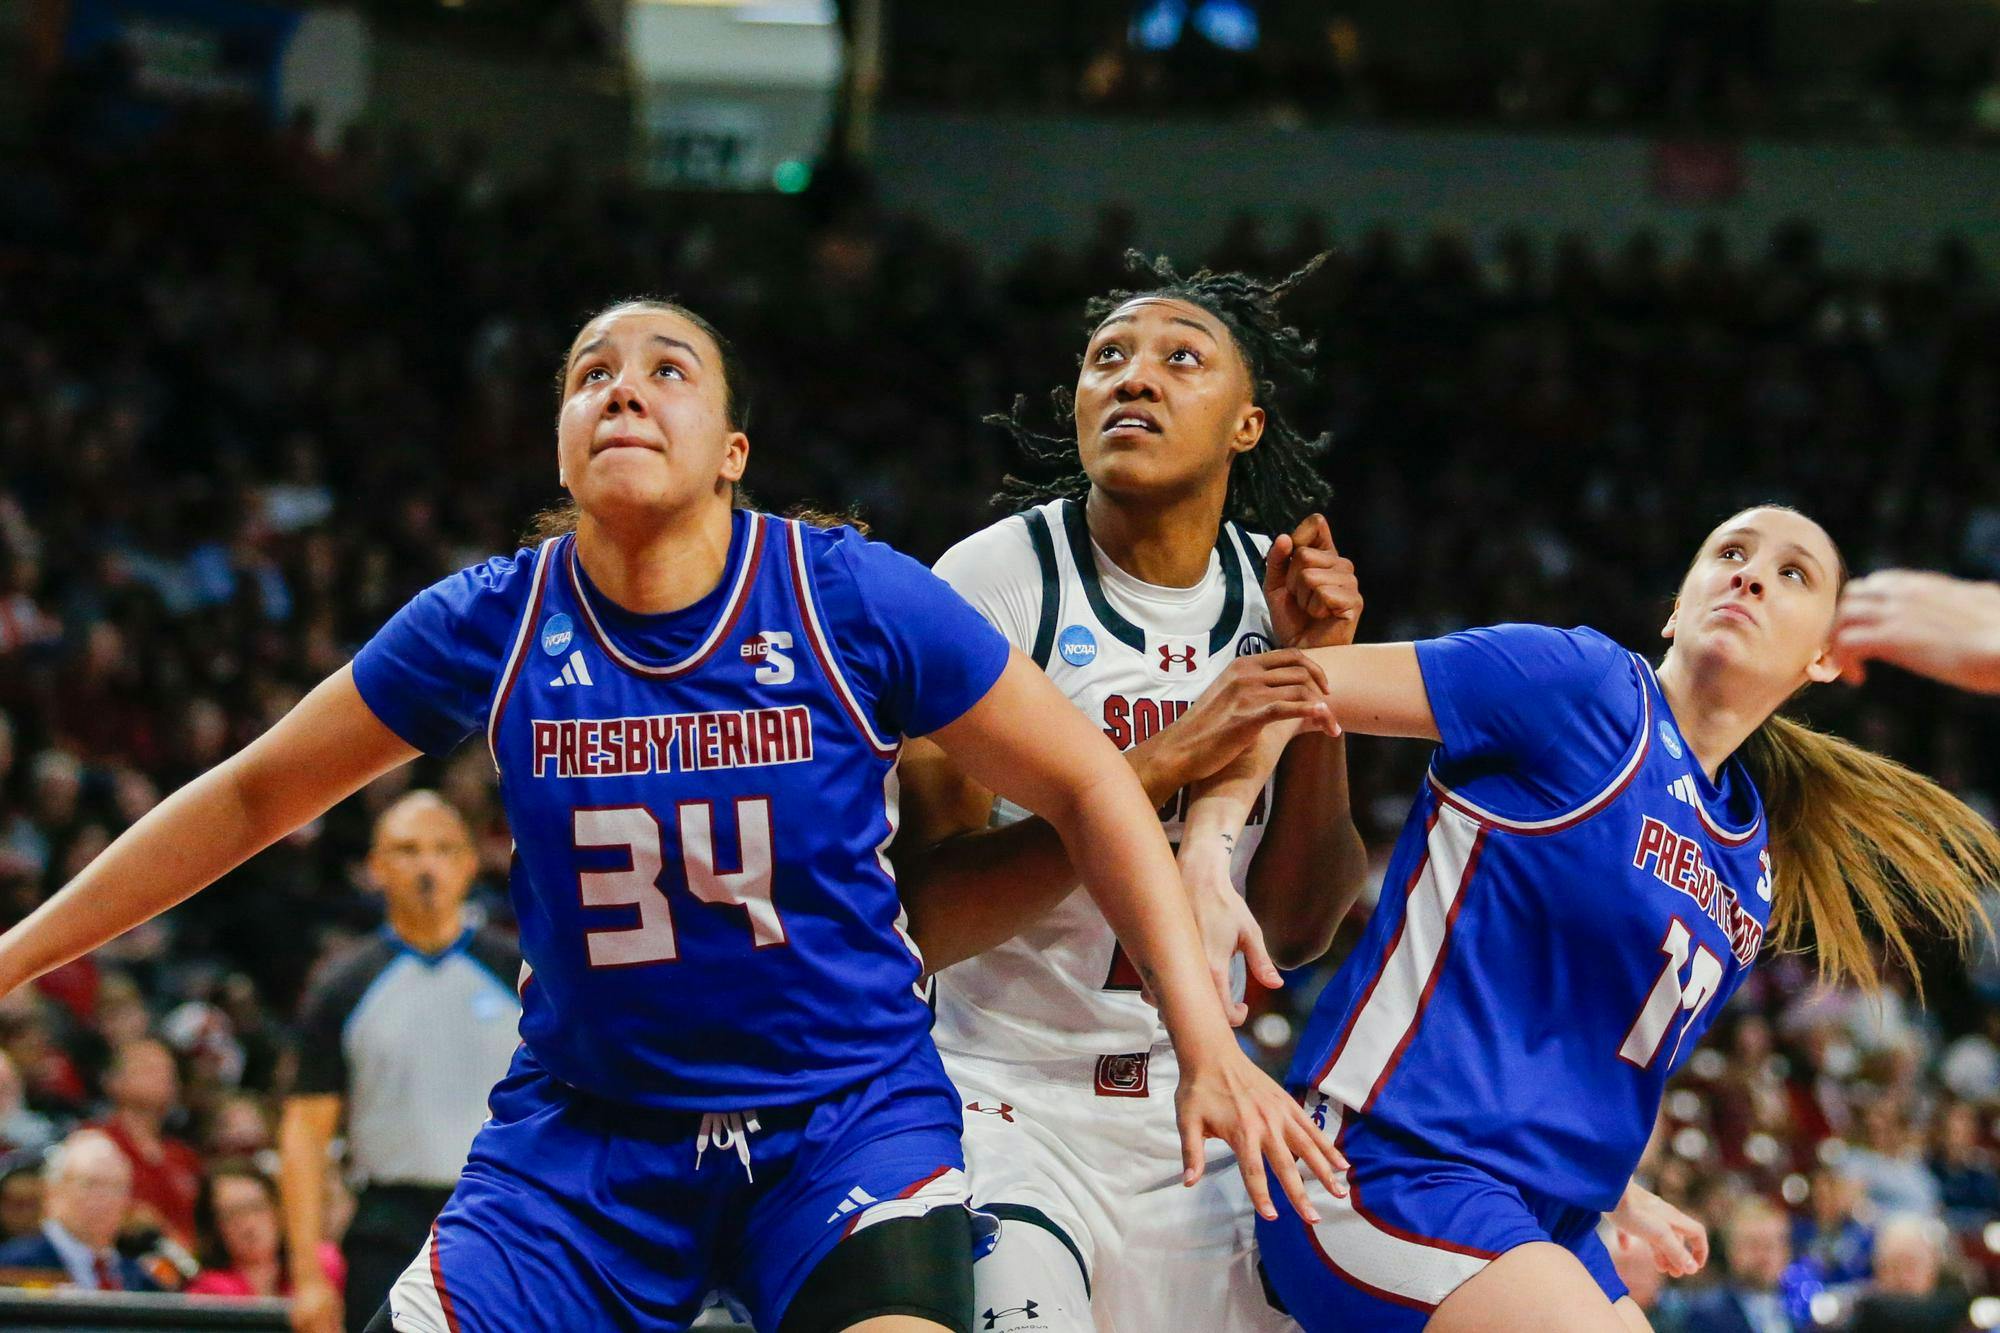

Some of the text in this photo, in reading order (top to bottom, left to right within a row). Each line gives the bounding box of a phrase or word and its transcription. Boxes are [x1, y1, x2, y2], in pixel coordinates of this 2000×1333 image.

[543, 631, 573, 648] NCAA
[740, 642, 769, 657] BIG
[1064, 643, 1096, 655] NCAA
[531, 705, 813, 778] PRESBYTERIAN
[572, 795, 789, 969] 34
